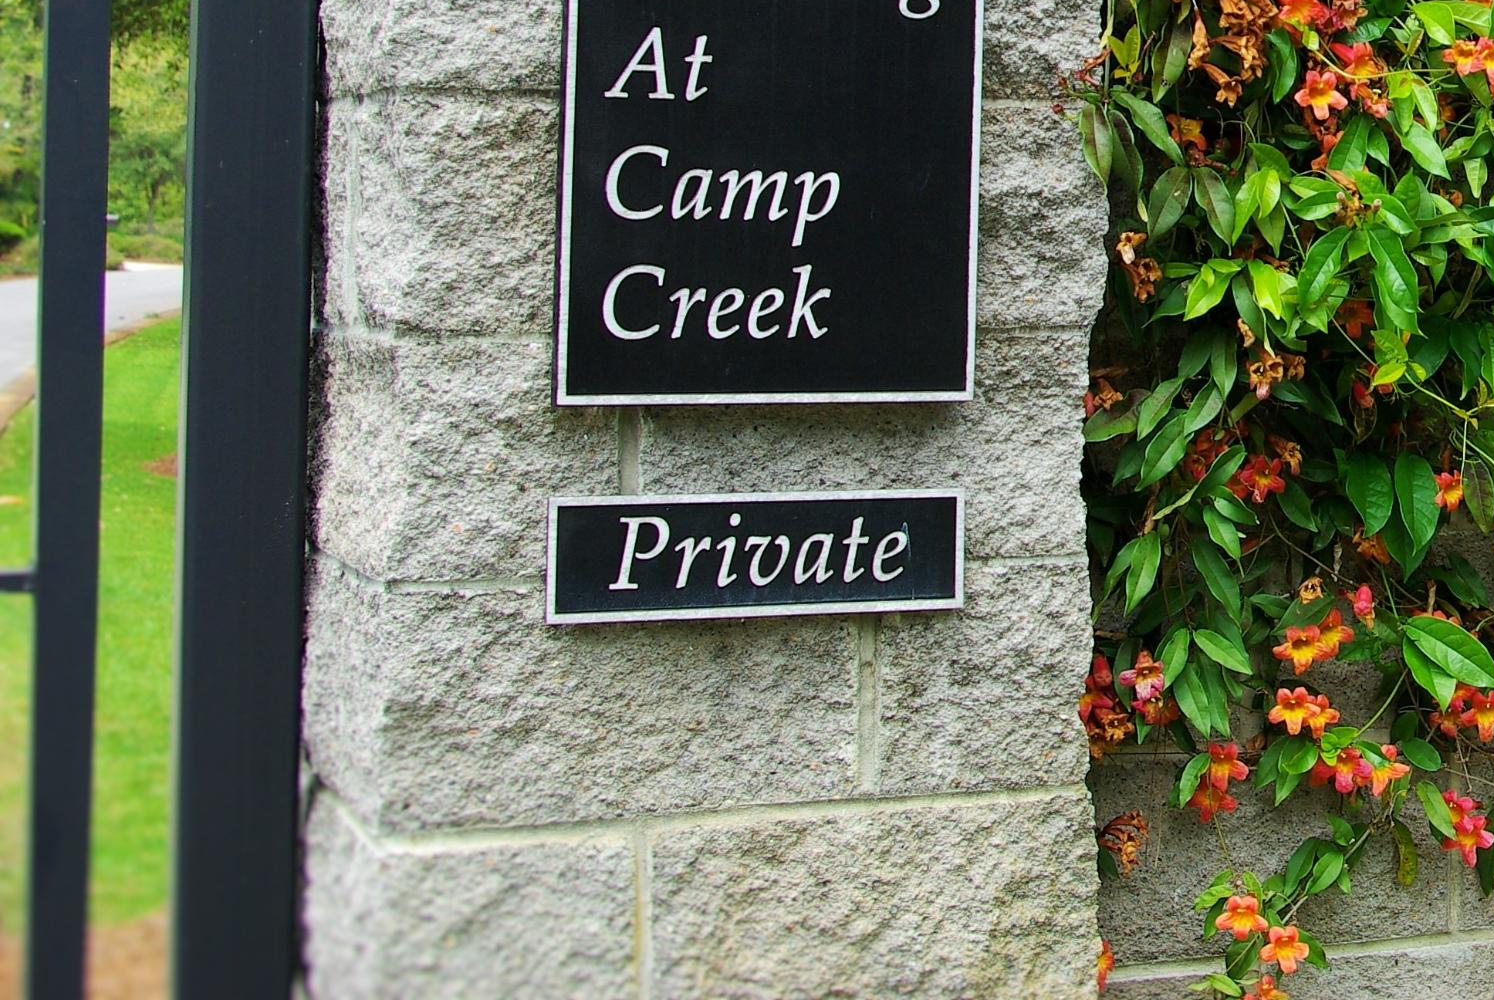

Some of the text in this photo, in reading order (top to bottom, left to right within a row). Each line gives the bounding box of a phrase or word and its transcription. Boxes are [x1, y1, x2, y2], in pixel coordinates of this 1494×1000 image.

[603, 25, 714, 103] At
[604, 143, 842, 248] Camp
[601, 263, 834, 341] Creek
[607, 512, 910, 591] Private
